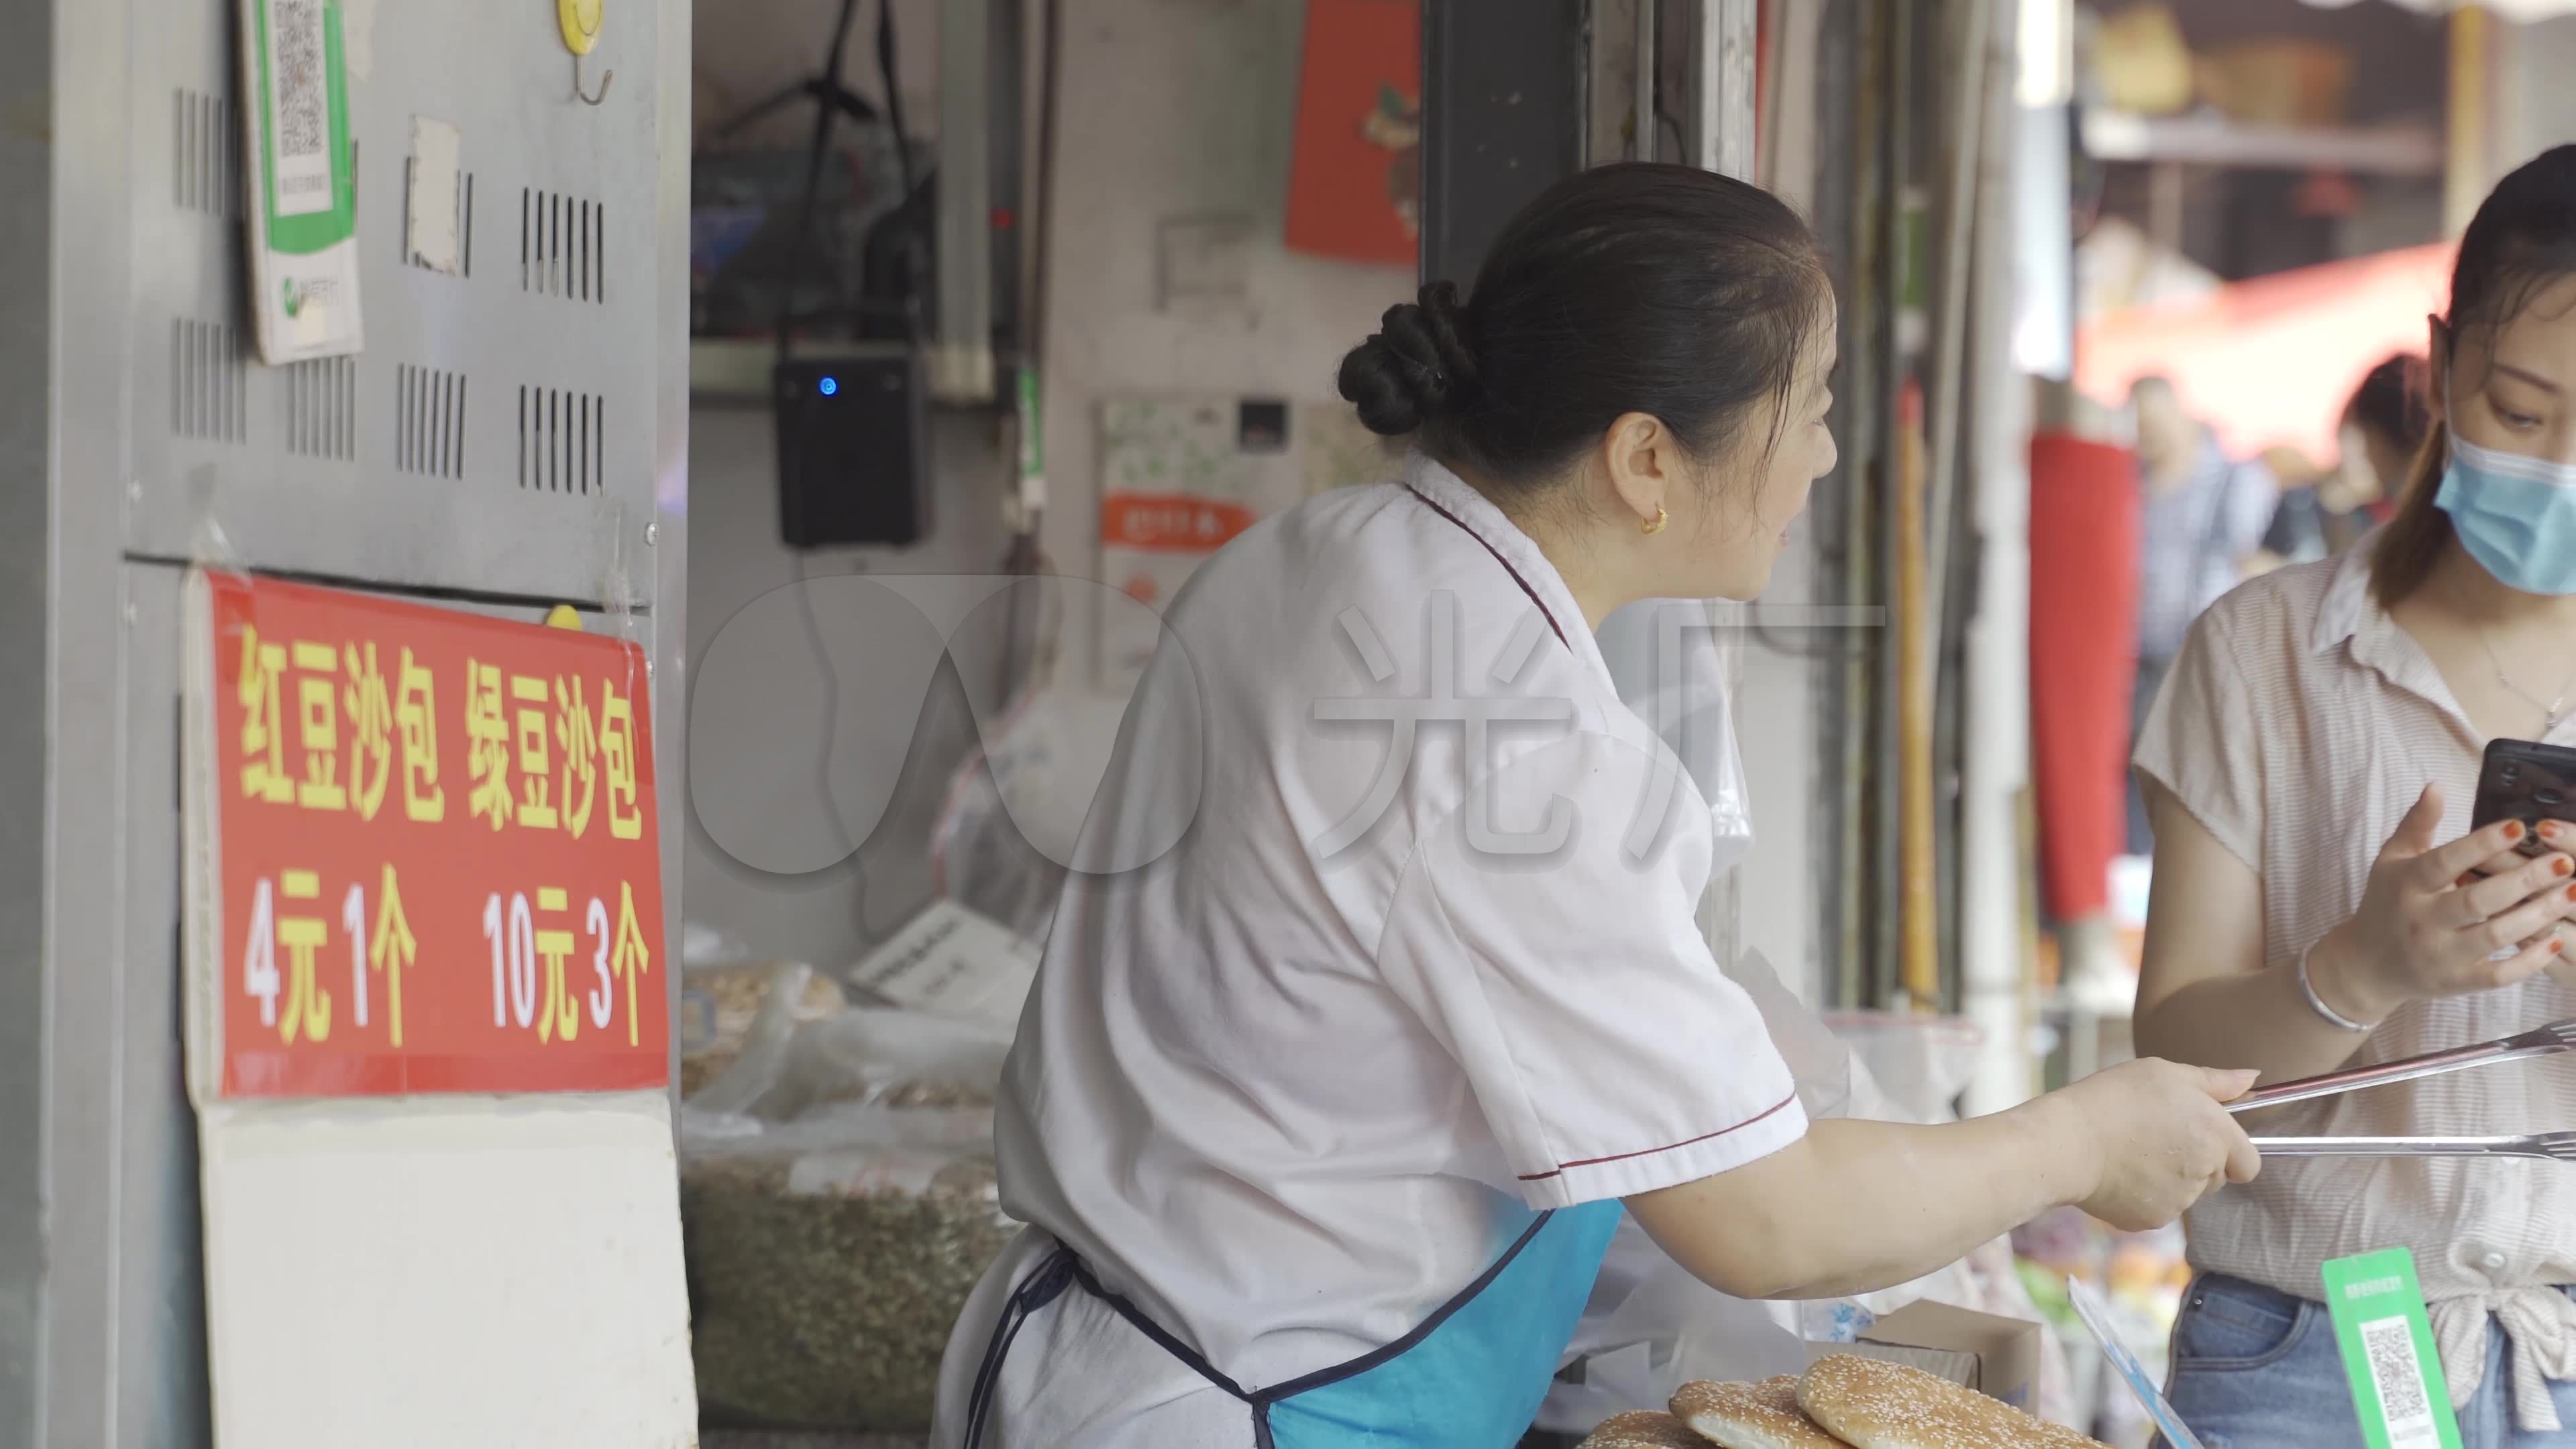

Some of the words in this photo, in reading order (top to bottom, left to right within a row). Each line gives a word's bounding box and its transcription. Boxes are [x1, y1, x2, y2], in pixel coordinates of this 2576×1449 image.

[239, 623, 444, 822] 红豆沙包
[466, 657, 642, 840] 绿豆沙包
